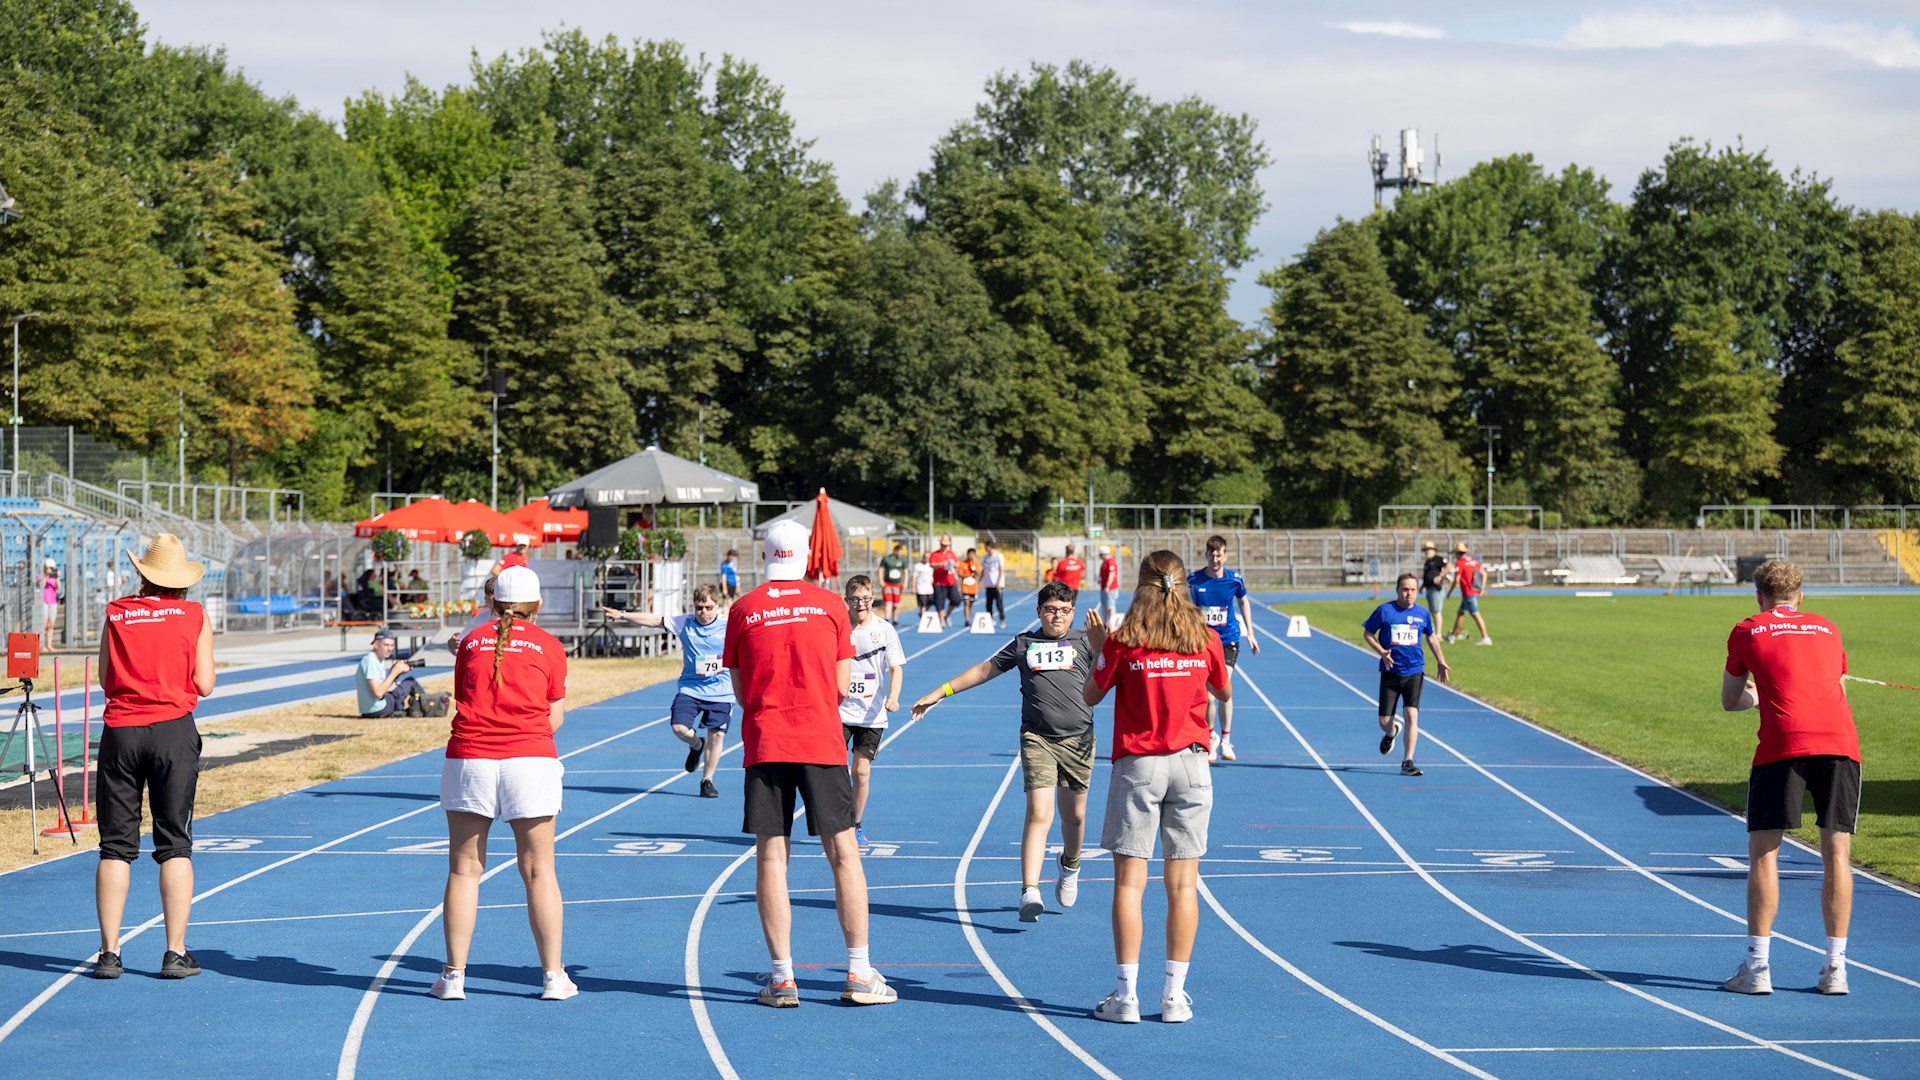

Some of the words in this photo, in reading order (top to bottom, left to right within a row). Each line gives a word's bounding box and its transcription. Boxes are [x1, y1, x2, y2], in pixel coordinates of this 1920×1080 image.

[774, 549, 793, 558] ABB
[110, 612, 124, 622] Ich
[125, 608, 150, 618] helfe
[152, 608, 185, 617] gerne.
[746, 612, 761, 625] Ich
[763, 606, 790, 619] helfe
[792, 606, 827, 616] gerne.
[926, 616, 933, 628] 7
[979, 617, 986, 628] 6
[1296, 620, 1301, 632] 1
[1751, 625, 1767, 635] Ich
[1769, 623, 1798, 631] helfe
[1800, 624, 1833, 635] gerne.
[1396, 632, 1413, 640] 176
[510, 639, 544, 655] gerne.
[1035, 650, 1065, 664] 113
[705, 663, 718, 671] 79
[1129, 660, 1144, 671] Ich
[1146, 658, 1174, 669] helfe
[1176, 659, 1207, 669] gerne.
[849, 682, 865, 693] 35
